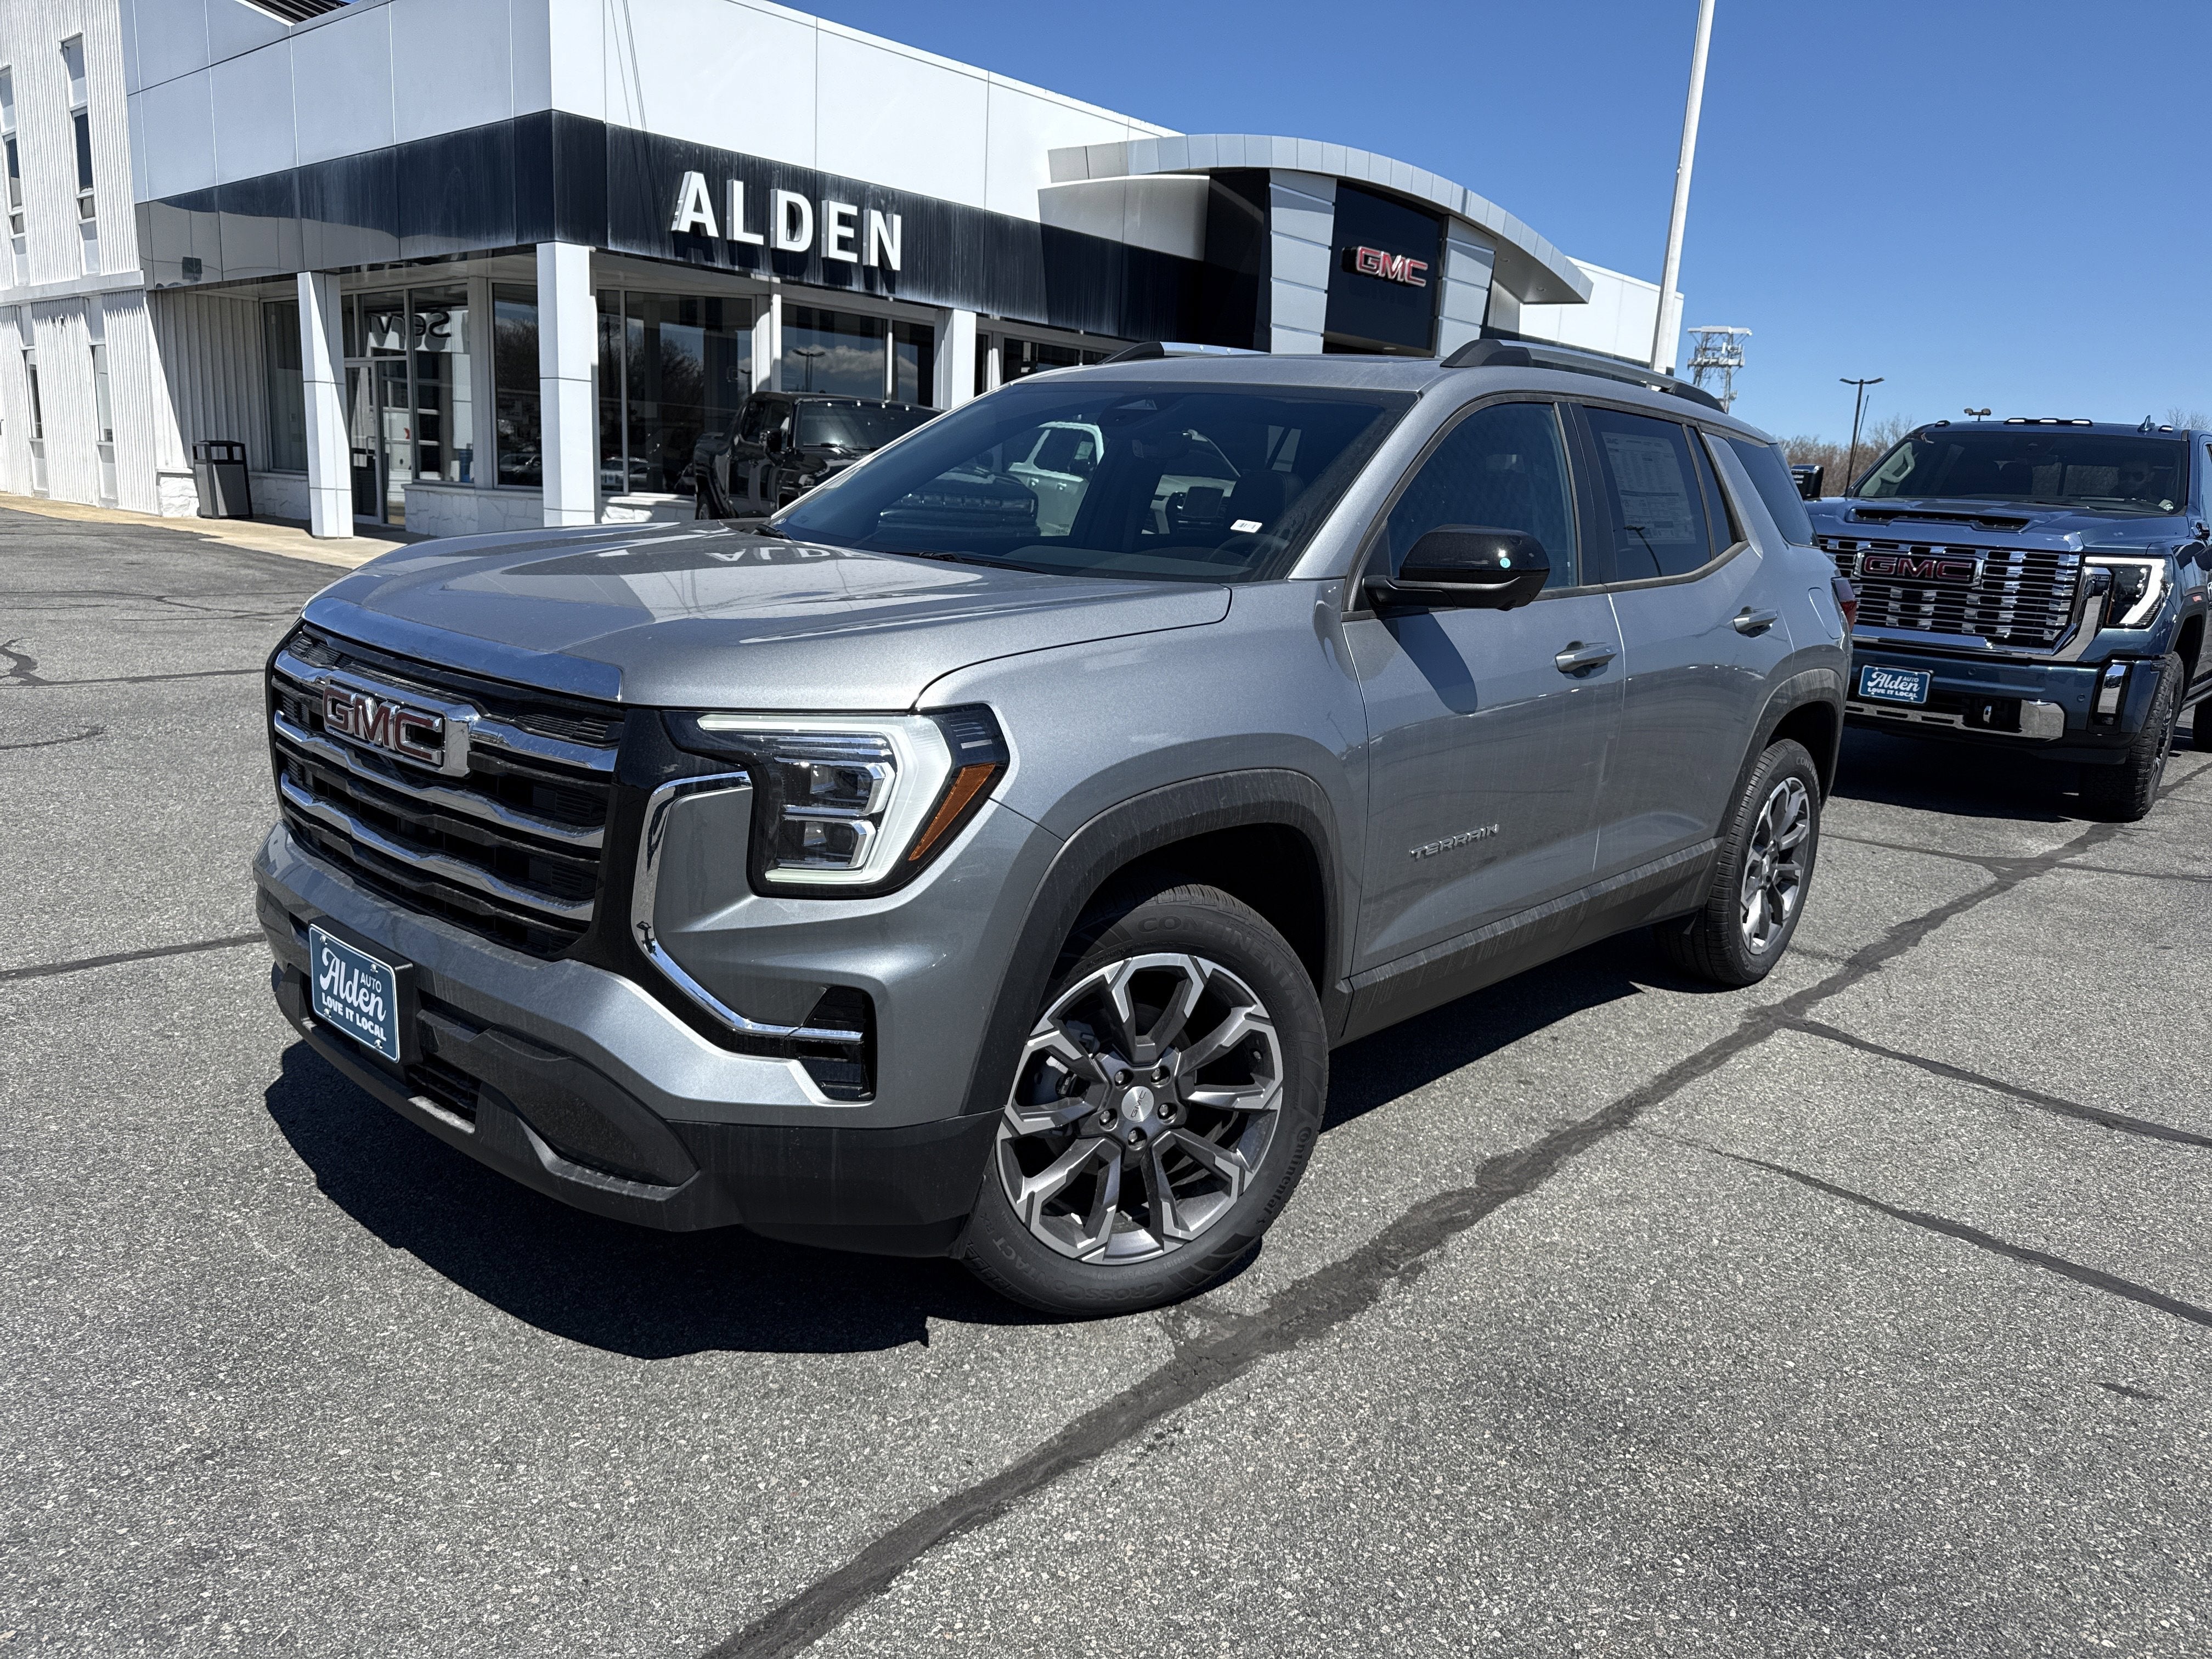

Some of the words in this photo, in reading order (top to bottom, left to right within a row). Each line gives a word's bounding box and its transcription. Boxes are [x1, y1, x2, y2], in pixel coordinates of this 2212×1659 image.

[671, 171, 901, 271] ALDEN
[1356, 246, 1428, 287] GMC
[1864, 555, 1972, 582] GMC
[1867, 671, 1920, 692] Alden
[323, 684, 442, 766] GMC
[1409, 823, 1499, 859] TERRAIN
[319, 947, 387, 1022] Alden
[360, 972, 382, 993] AUTO
[1137, 915, 1308, 1024] CONTINENTAL
[321, 992, 343, 1017] LOVE
[346, 1007, 354, 1023] IT
[356, 1014, 387, 1042] LOCAL
[1130, 1090, 1147, 1118] GMC
[1263, 1126, 1312, 1215] Continental
